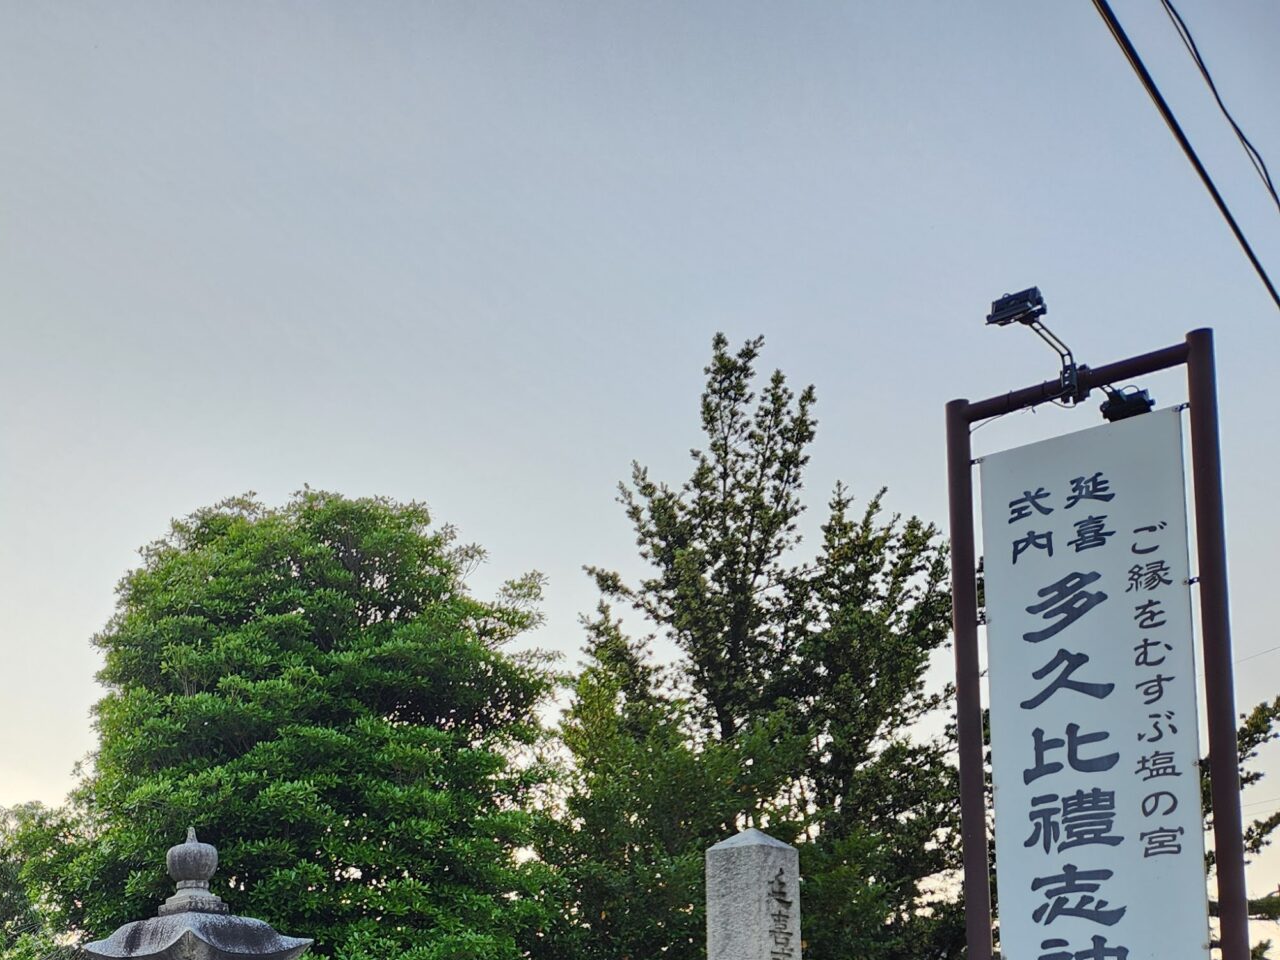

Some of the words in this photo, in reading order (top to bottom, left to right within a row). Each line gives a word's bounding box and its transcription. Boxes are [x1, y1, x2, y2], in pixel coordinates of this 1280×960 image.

[1007, 487, 1055, 565] 式内
[1063, 471, 1117, 553] 延喜
[1124, 520, 1186, 859] ご縁をむすぶ塩の宮
